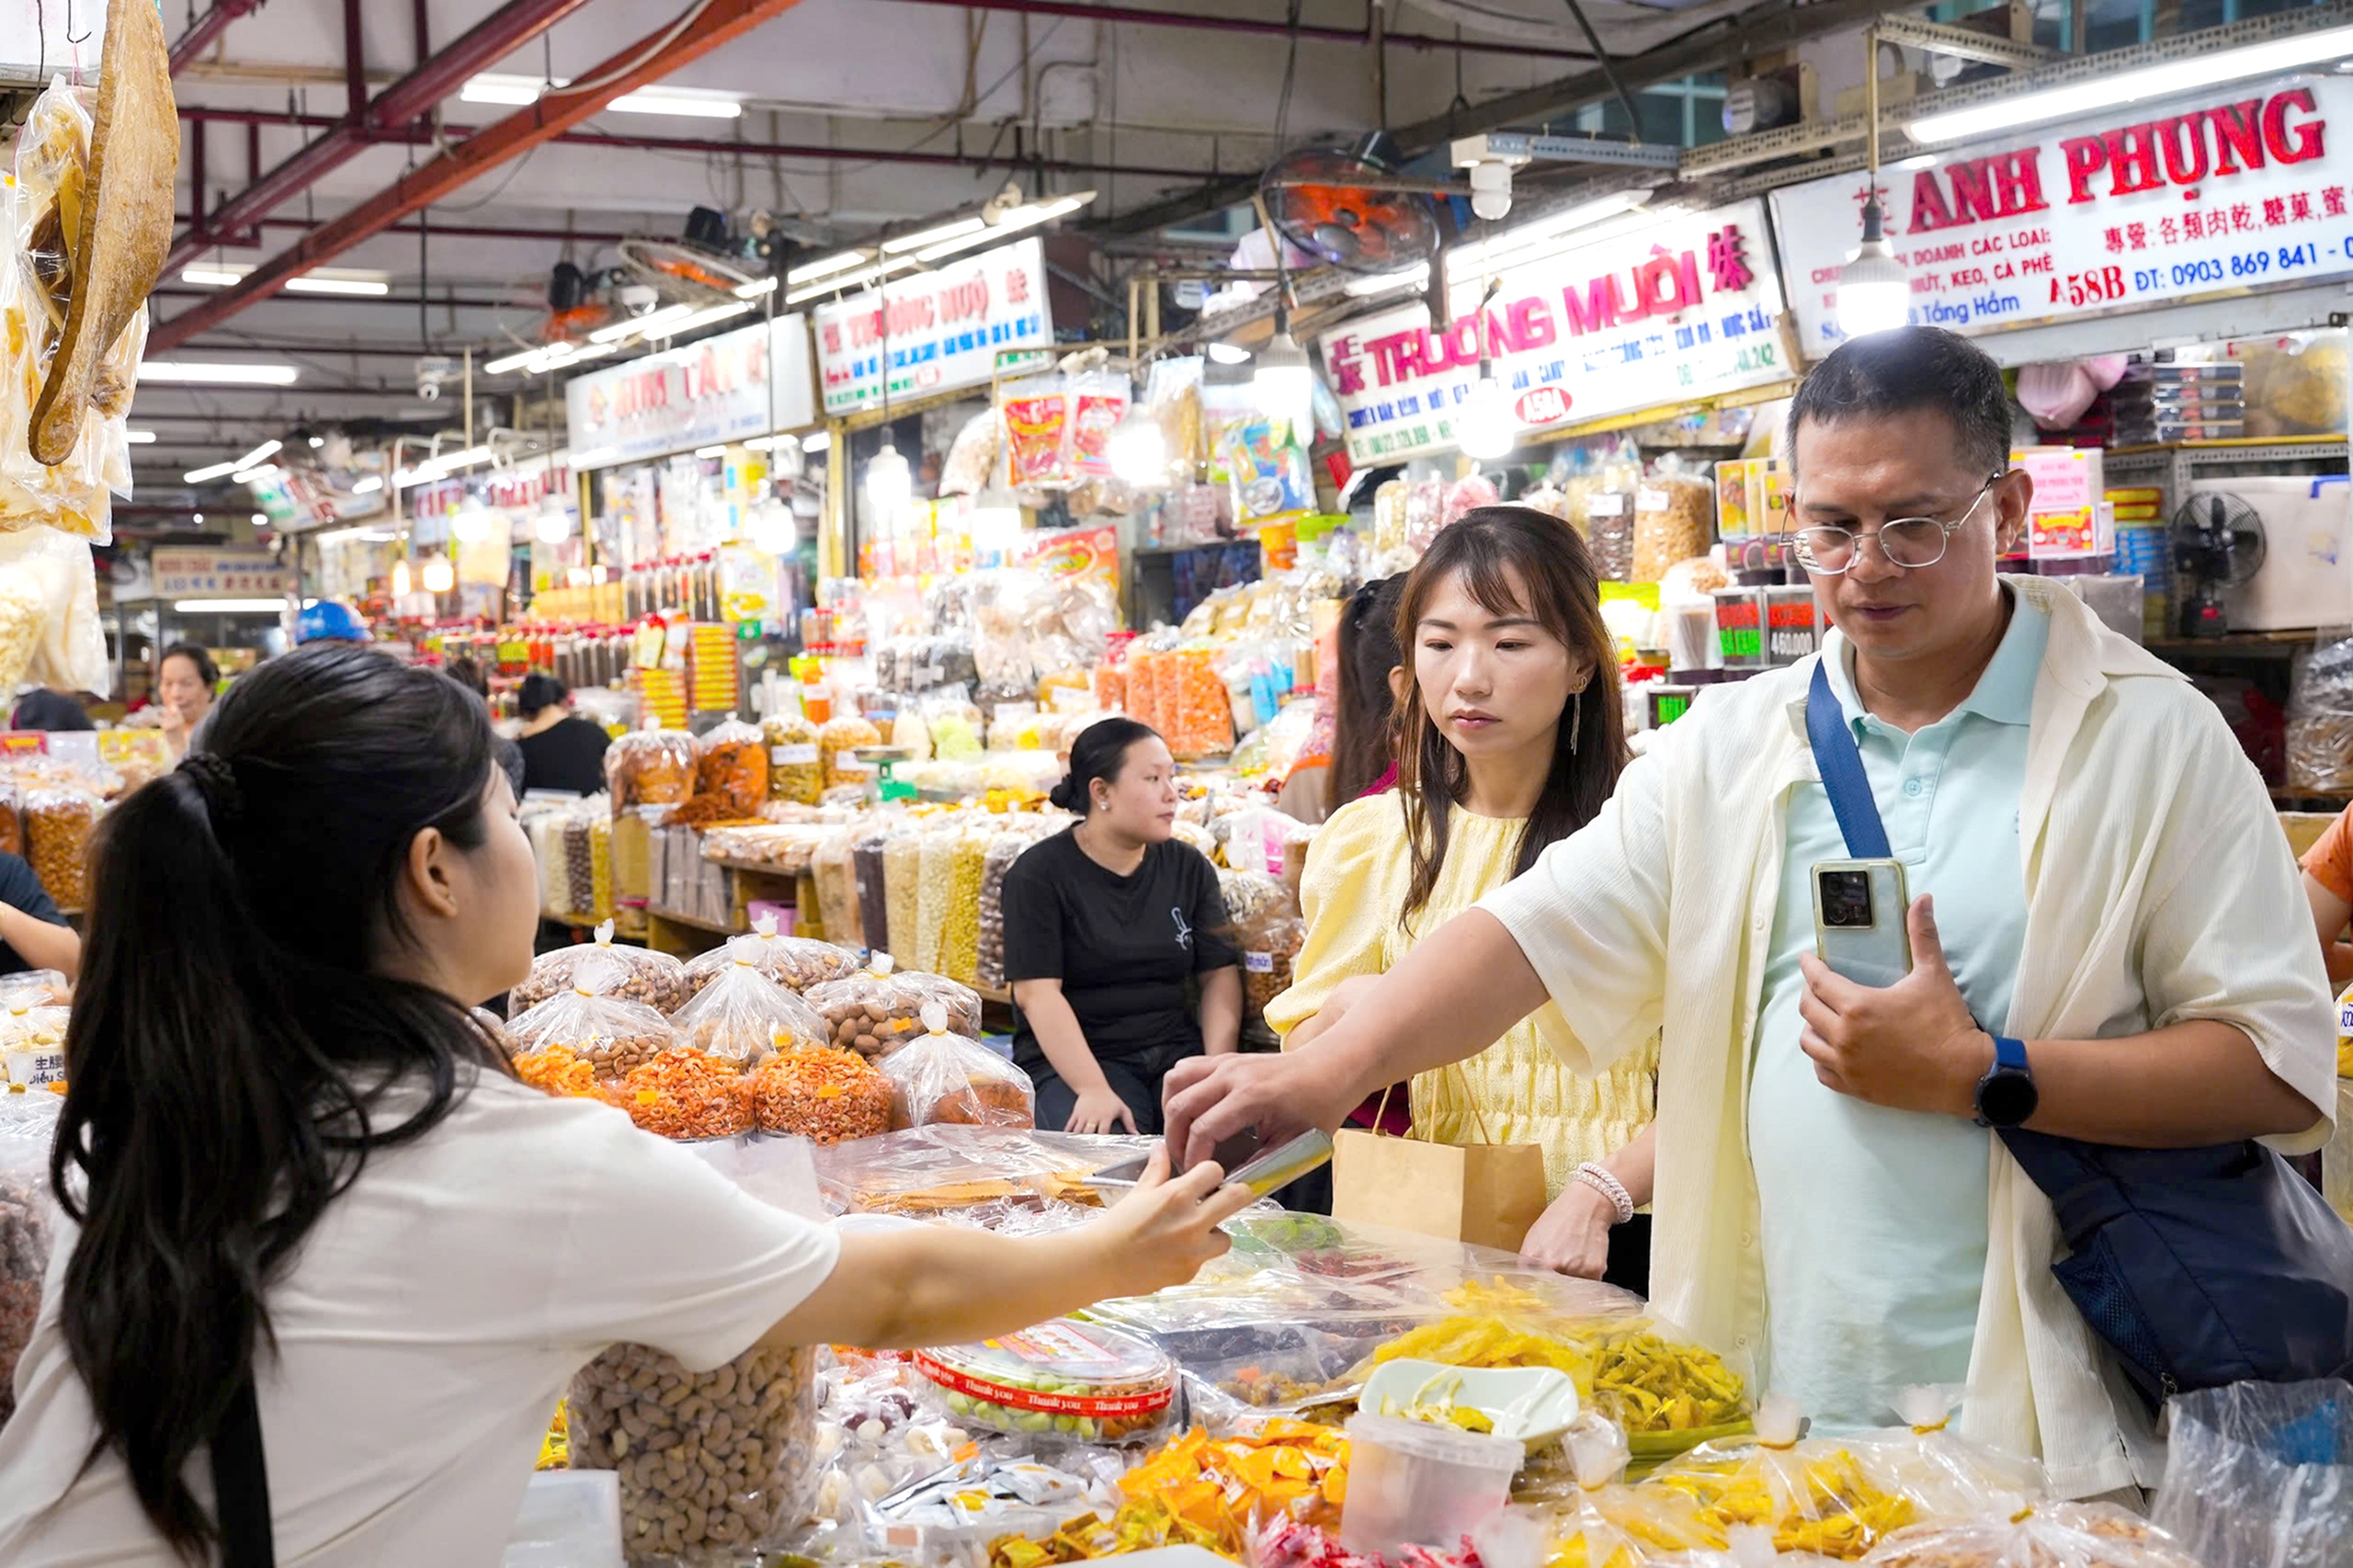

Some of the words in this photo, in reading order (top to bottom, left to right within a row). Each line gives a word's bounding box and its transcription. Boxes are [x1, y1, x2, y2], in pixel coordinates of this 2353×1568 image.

[1906, 146, 2051, 236] ANH
[2059, 87, 2326, 204] PHỤNG
[1913, 242, 1966, 266] DOANH
[1972, 233, 2004, 256] CÁC
[1952, 267, 1989, 291] KẸO,
[2022, 255, 2054, 276] PHÊ
[2134, 269, 2166, 292] ĐT:
[2172, 259, 2223, 287] 0903
[2231, 251, 2270, 277] 869
[2278, 243, 2317, 269] 841
[2049, 266, 2126, 307] A58B
[965, 1379, 994, 1396] Thank
[994, 1388, 1014, 1401] you
[1028, 1393, 1061, 1408] Thank
[1061, 1397, 1082, 1411] you
[1095, 1400, 1123, 1411] Thank
[1122, 1402, 1139, 1412] you
